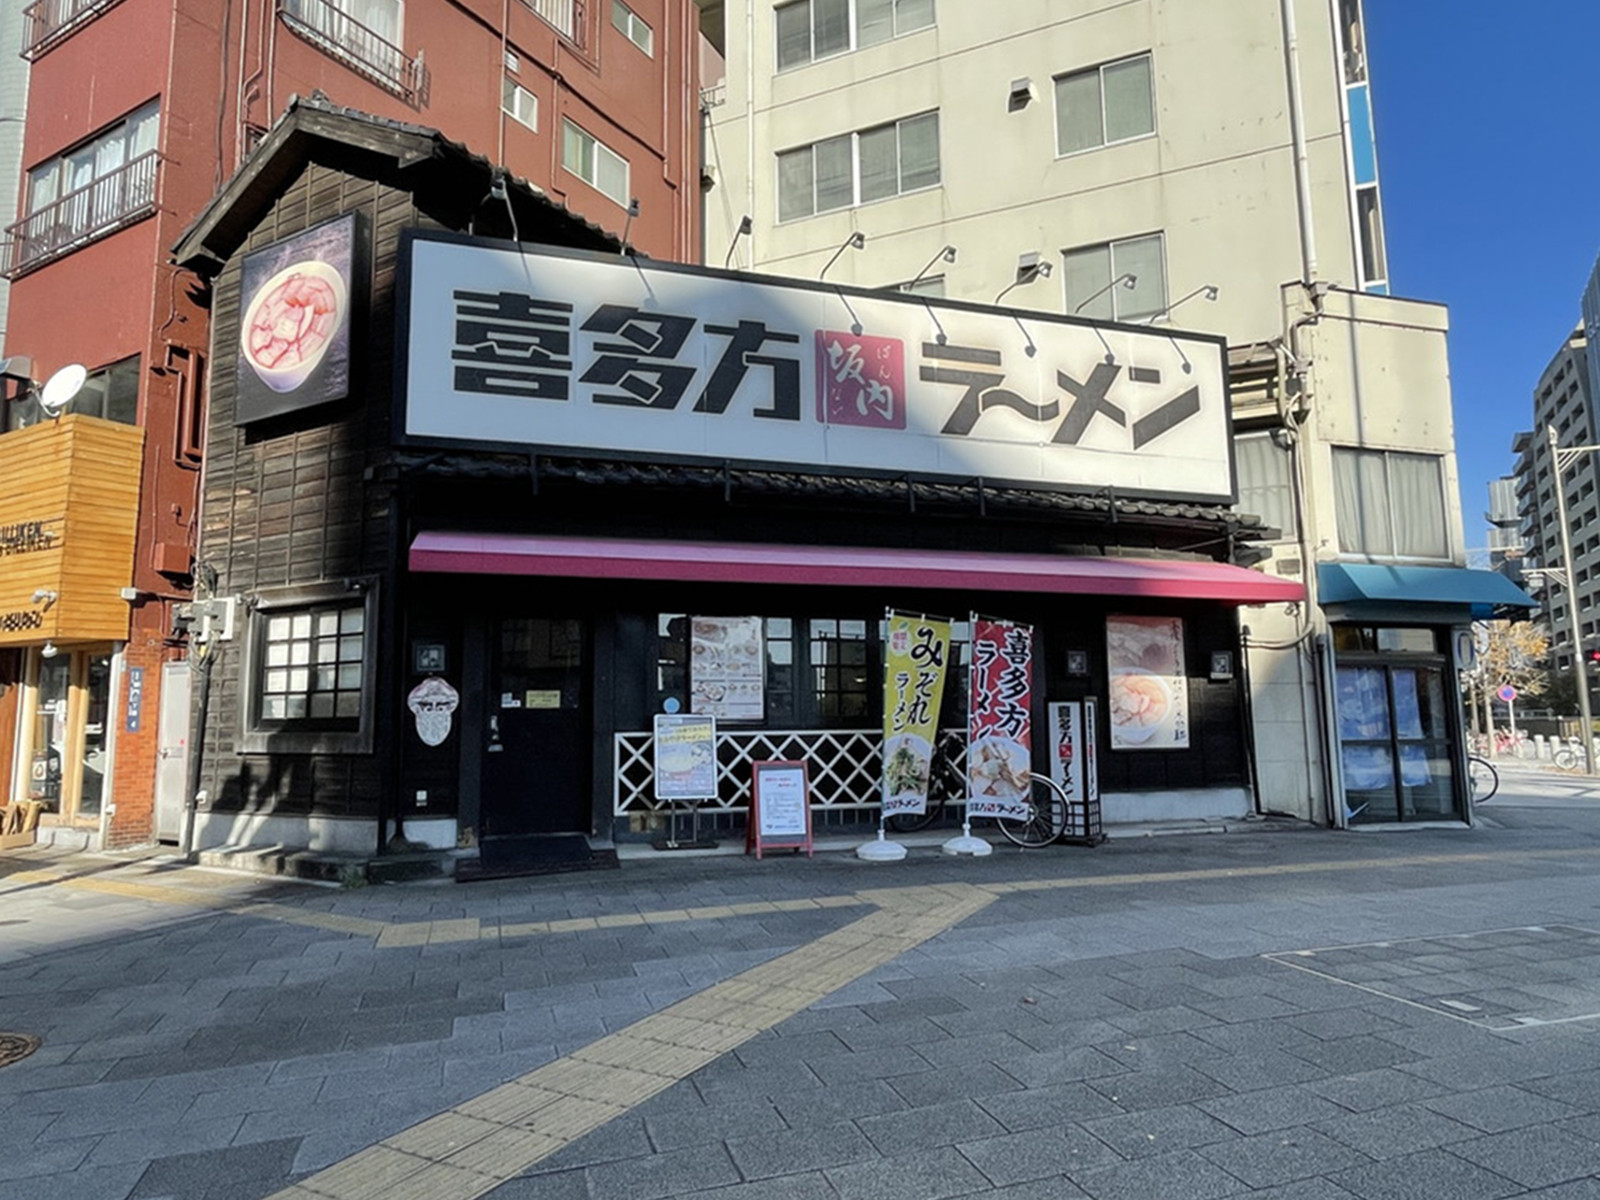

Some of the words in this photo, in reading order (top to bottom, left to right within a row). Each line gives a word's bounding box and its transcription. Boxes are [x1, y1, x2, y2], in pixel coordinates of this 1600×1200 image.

[452, 291, 800, 421] 喜多方
[827, 340, 893, 421] 坂内
[919, 342, 1200, 450] ラーメン
[893, 672, 910, 731] ラーメン
[907, 626, 943, 725] みぞれ
[976, 642, 996, 740] ラーメン
[996, 629, 1030, 738] 喜多方
